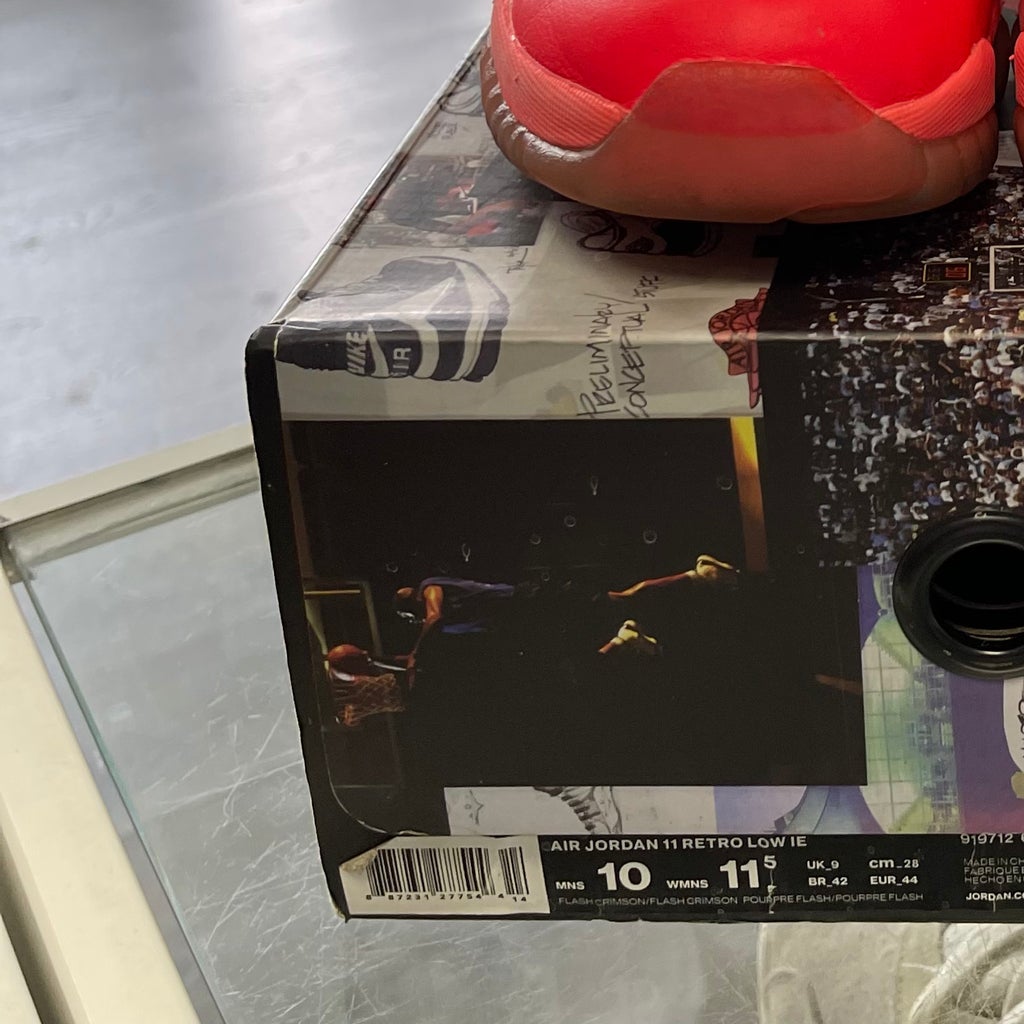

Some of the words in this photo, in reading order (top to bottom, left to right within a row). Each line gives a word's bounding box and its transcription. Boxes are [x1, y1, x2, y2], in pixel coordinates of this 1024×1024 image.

[550, 839, 581, 852] AIR
[585, 838, 659, 851] JORDAN
[662, 838, 678, 850] 11
[682, 836, 744, 849] RETRO
[747, 836, 786, 848] LOW
[789, 835, 808, 847] IE
[960, 832, 1014, 846] 919712
[963, 857, 994, 866] MADE
[995, 857, 1009, 866] IN
[555, 880, 585, 890] MNS
[597, 861, 652, 891] 10
[666, 879, 709, 889] WMNS
[719, 859, 761, 889] 11
[763, 855, 777, 869] 5
[963, 866, 1020, 875] FABRIQUE
[964, 874, 1005, 884] HECHO
[1006, 874, 1021, 883] EN
[557, 896, 595, 906] FLASH
[686, 895, 738, 905] CRIMSON
[888, 892, 924, 902] FLASH
